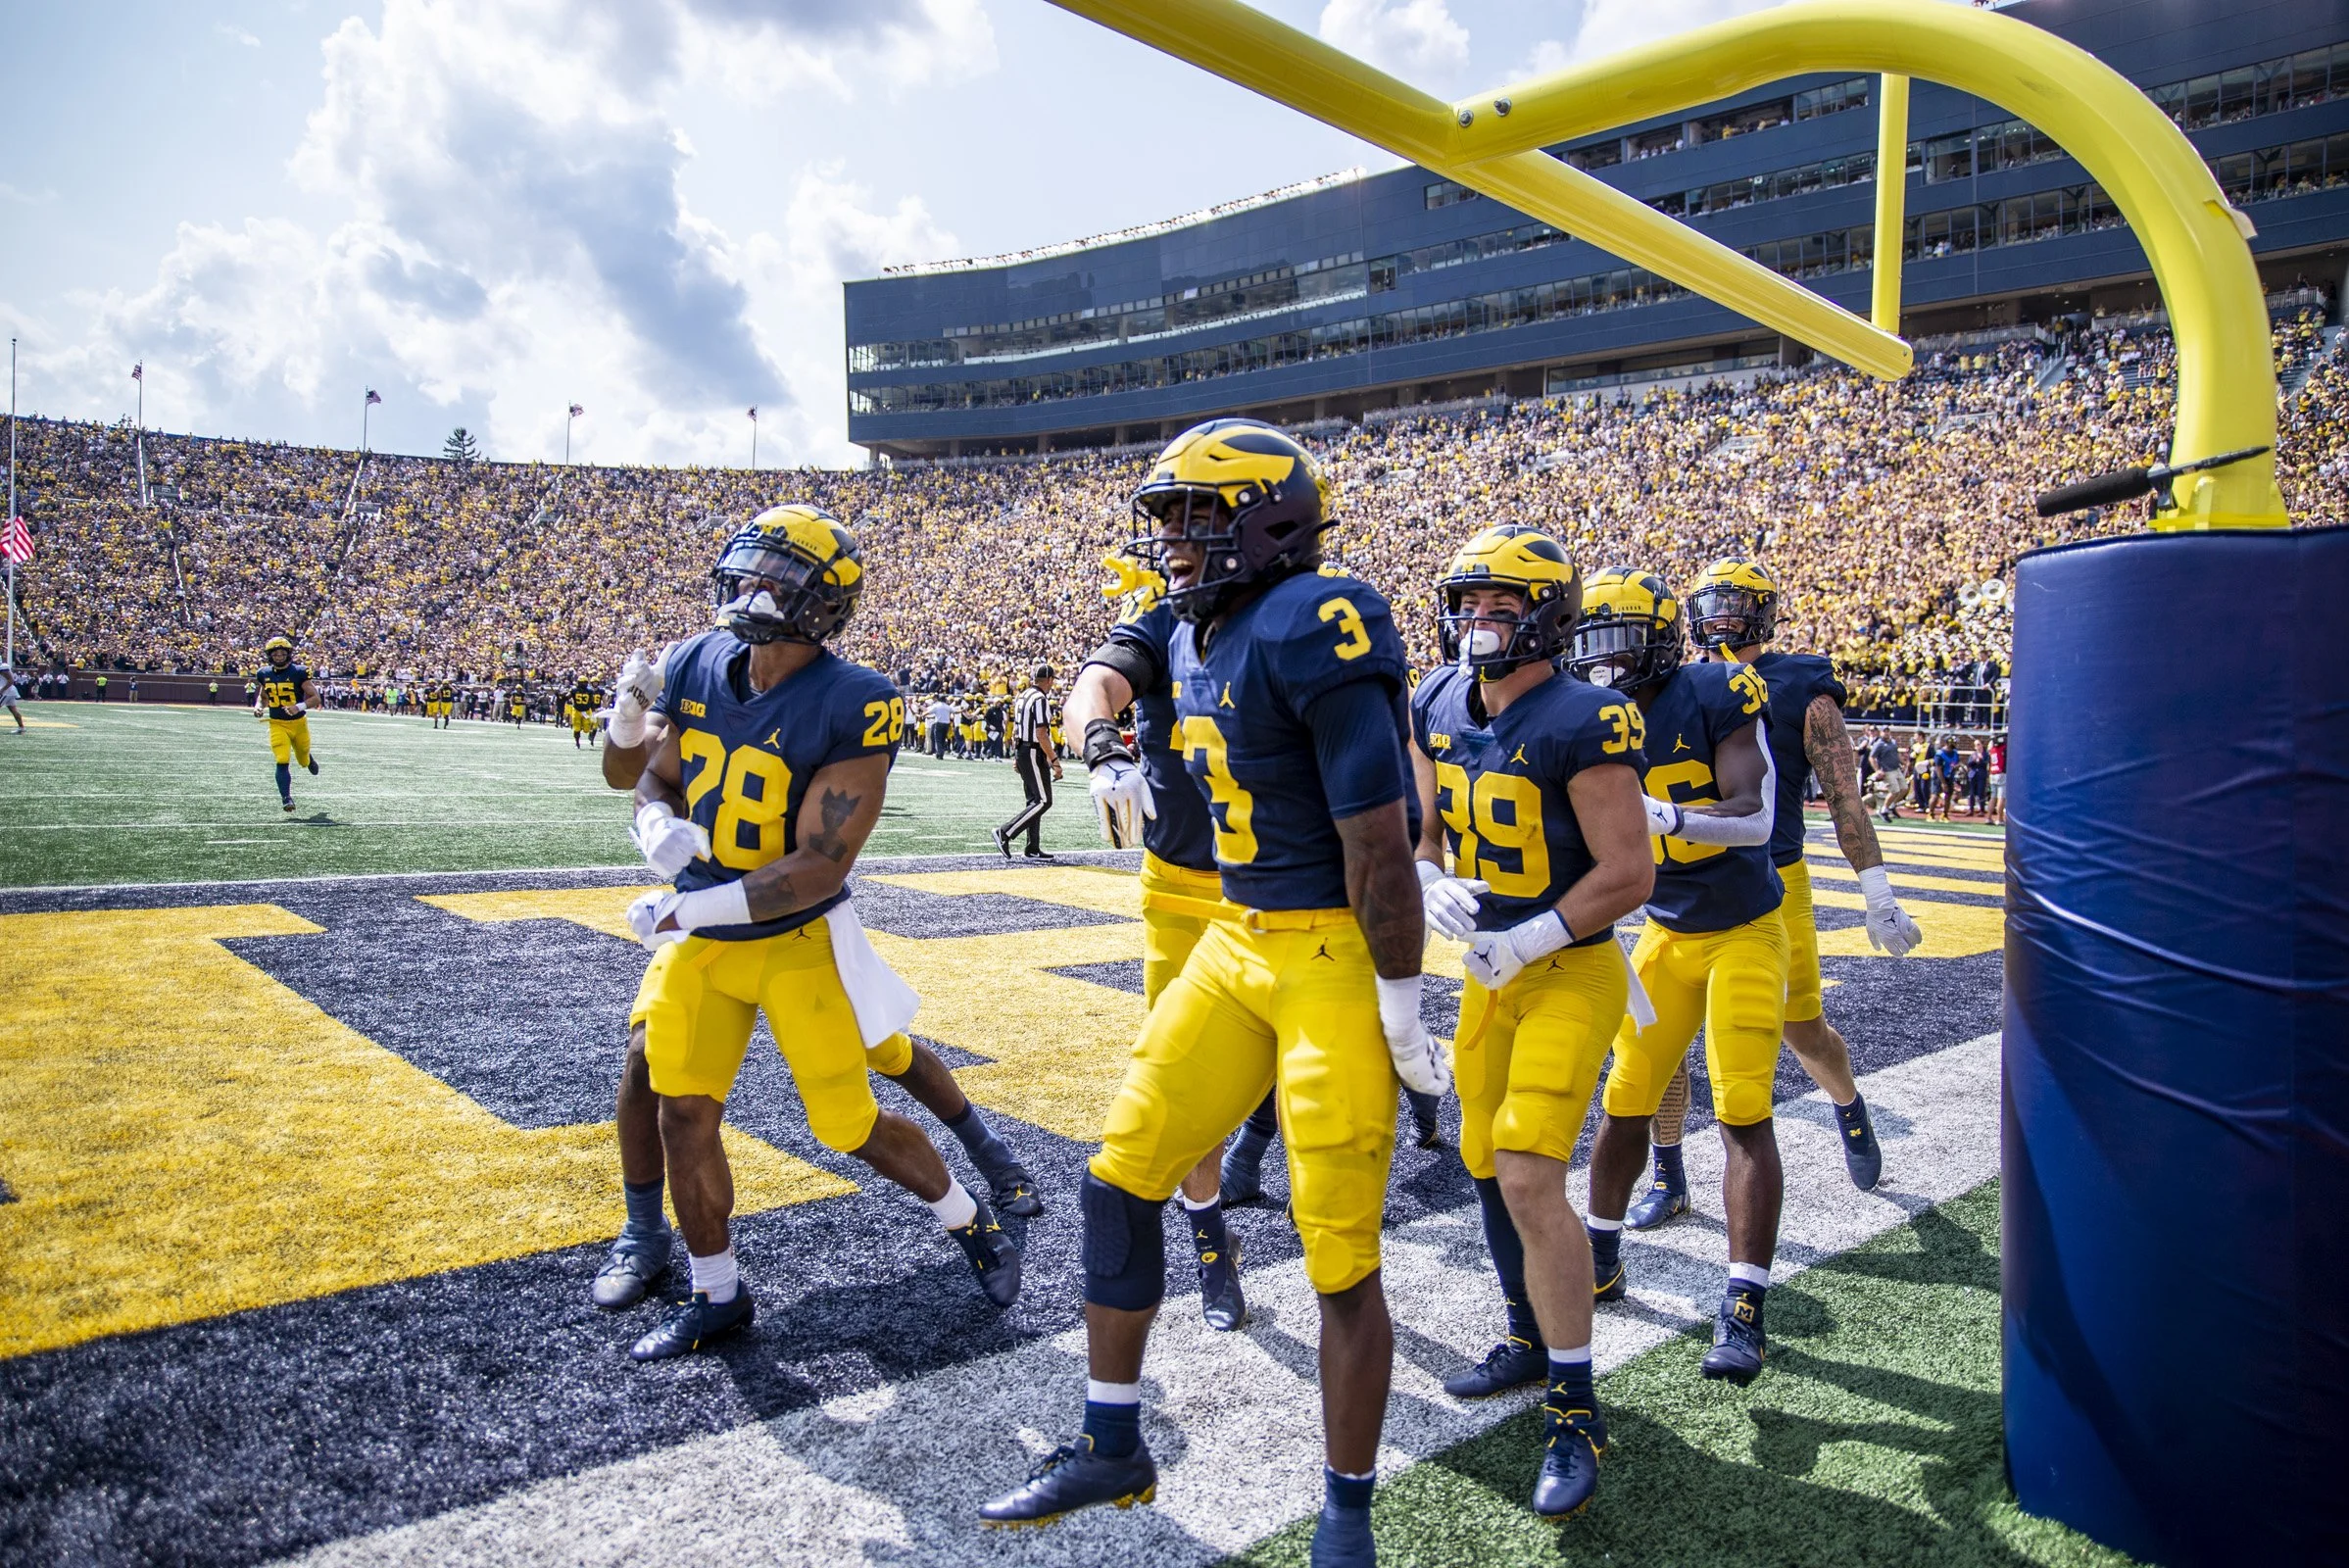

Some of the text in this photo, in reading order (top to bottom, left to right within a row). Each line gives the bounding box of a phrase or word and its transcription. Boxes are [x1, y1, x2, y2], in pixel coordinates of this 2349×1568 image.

[1318, 597, 1372, 661] 3
[264, 682, 297, 708] 35
[575, 694, 589, 705] 53
[862, 697, 905, 747] 28
[1598, 702, 1646, 755] 39
[679, 727, 793, 870] 28
[1182, 715, 1259, 864] 3
[1435, 760, 1551, 898] 39
[1737, 1304, 1753, 1320] M
